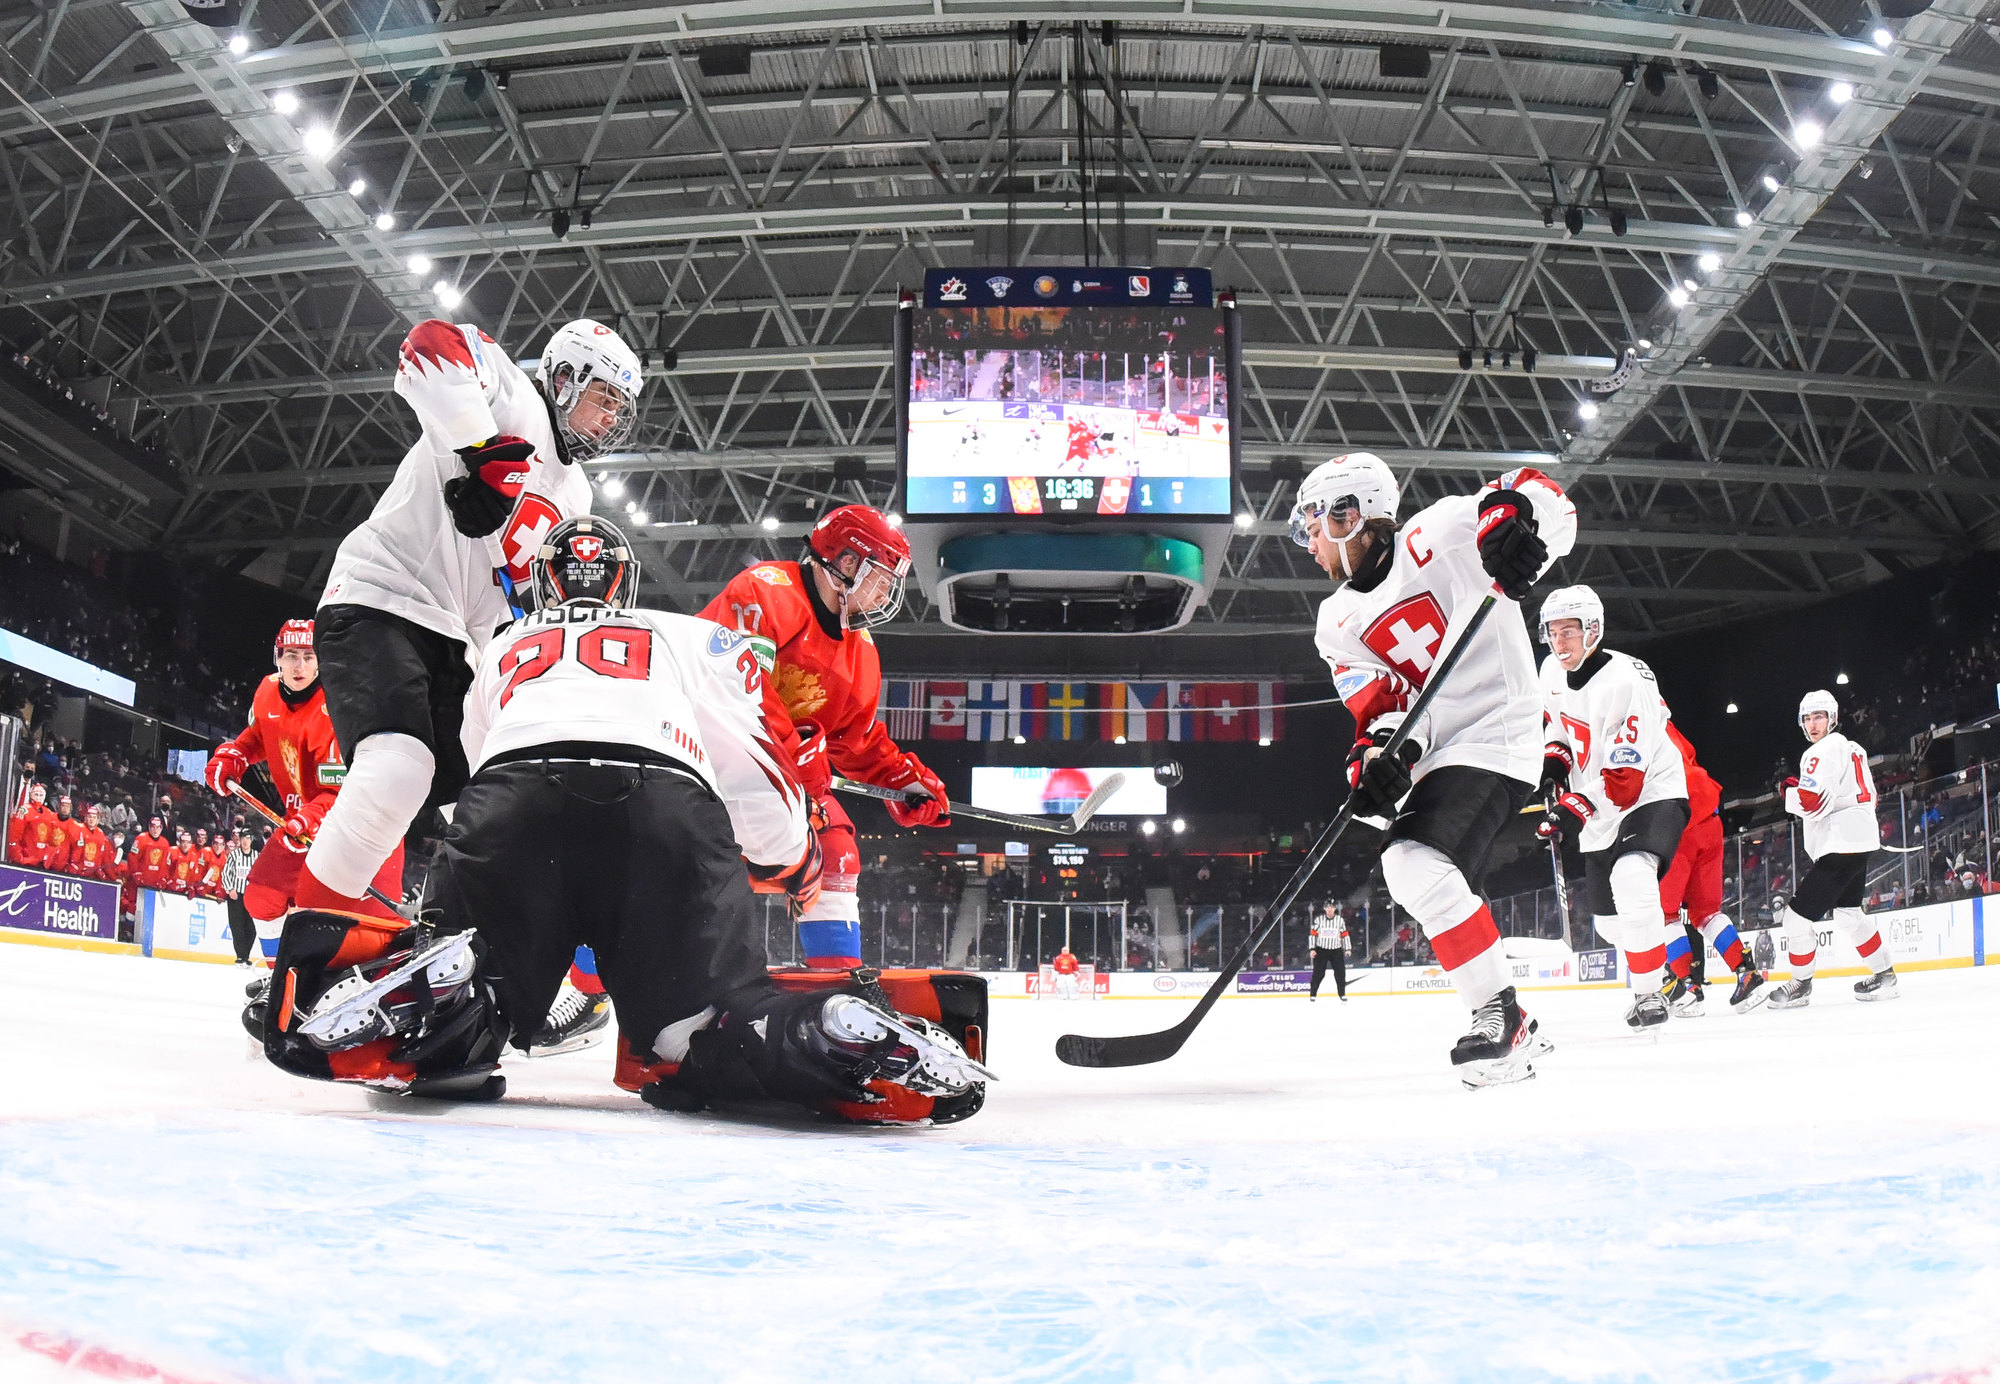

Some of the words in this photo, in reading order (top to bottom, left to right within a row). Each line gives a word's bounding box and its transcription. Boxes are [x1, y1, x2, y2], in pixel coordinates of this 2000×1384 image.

[503, 470, 526, 484] BA
[983, 483, 996, 505] 3
[1045, 478, 1094, 499] 16:36
[1141, 483, 1153, 506] 1
[850, 536, 872, 552] CCM
[1405, 526, 1433, 569] C
[731, 602, 763, 635] 17
[499, 625, 652, 710] 29
[1614, 715, 1639, 744] 15
[674, 727, 705, 764] IIHF
[1613, 749, 1637, 763] Ford
[1852, 752, 1871, 803] 1
[43, 878, 83, 901] TELUS
[44, 901, 99, 934] Health
[1904, 917, 1923, 936] BFL
[1157, 980, 1174, 988] Esso
[1238, 981, 1273, 991] Powered
[1274, 982, 1284, 992] by
[1284, 981, 1311, 991] Purpos
[1406, 979, 1453, 989] CHEVROLE
